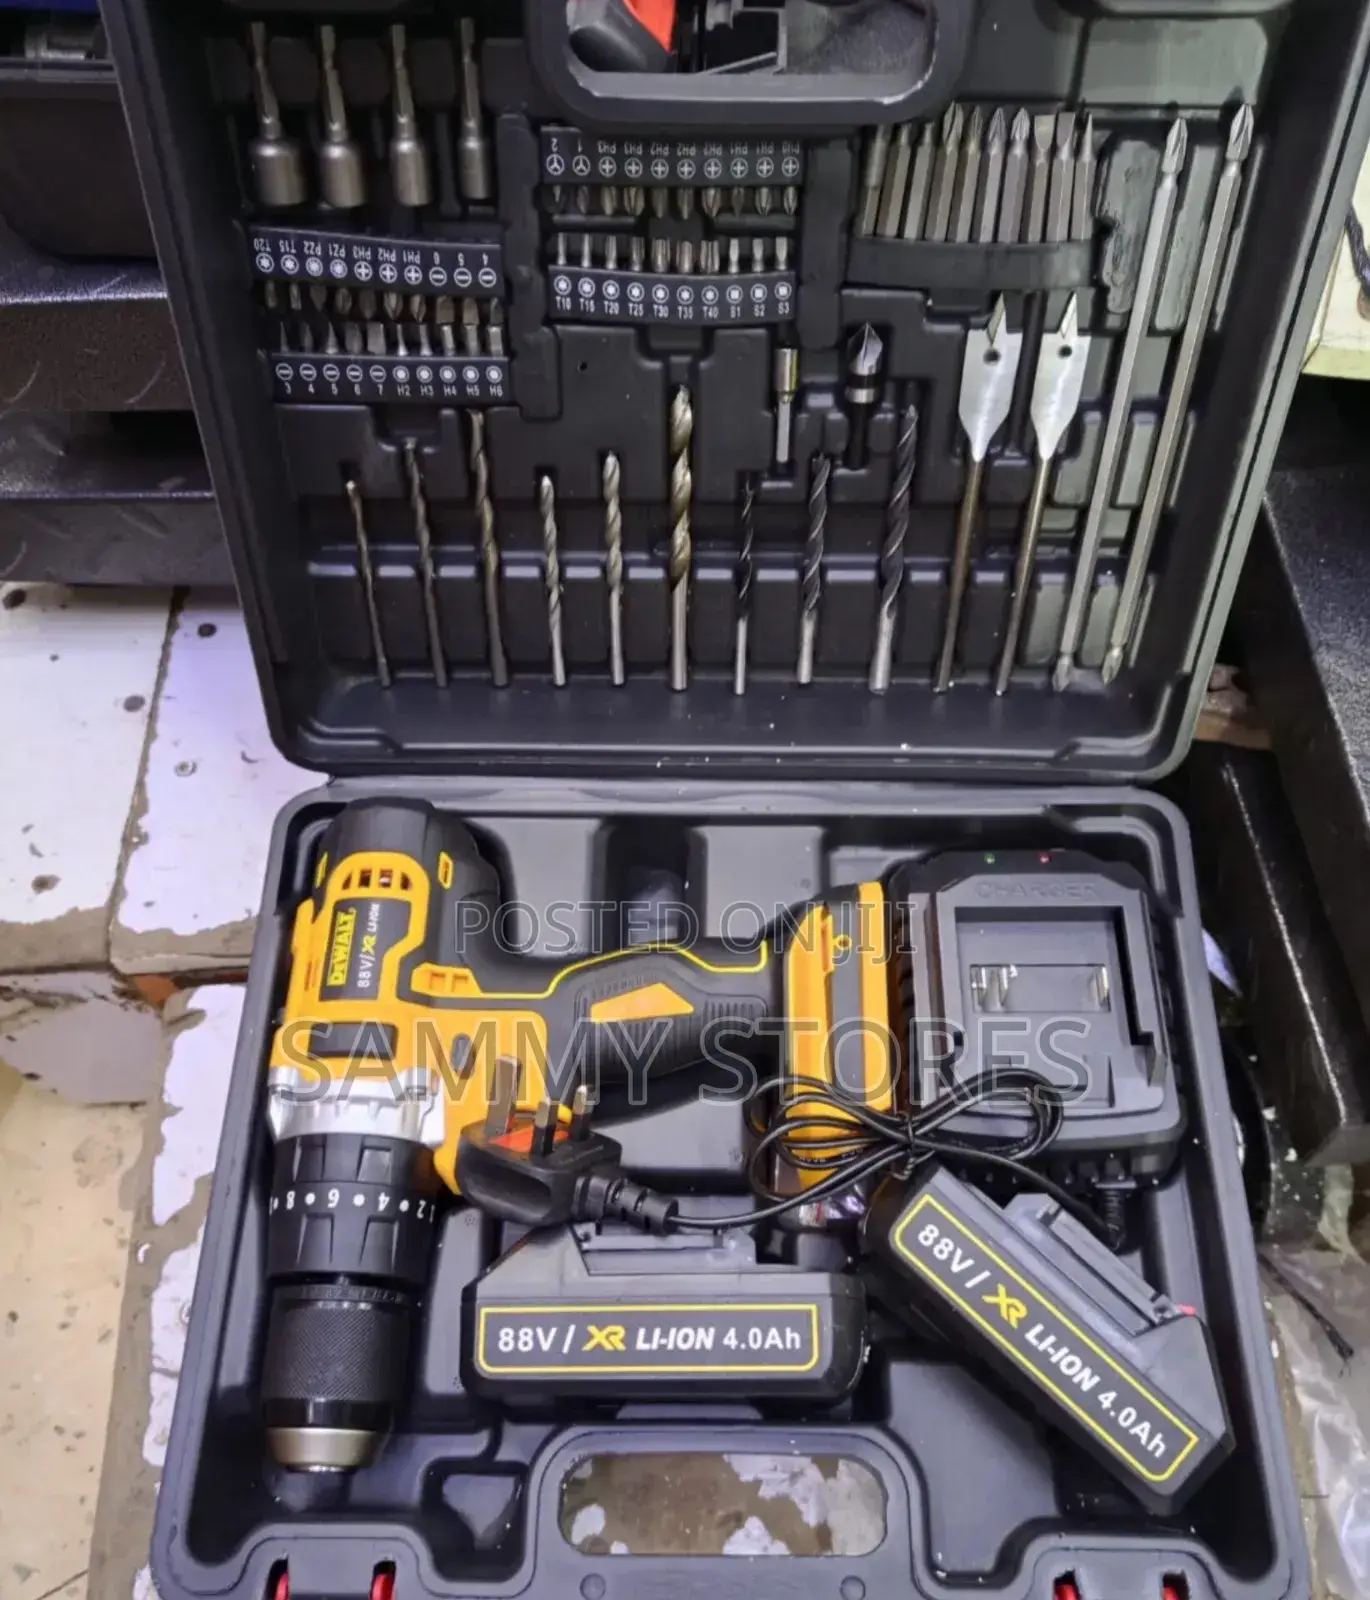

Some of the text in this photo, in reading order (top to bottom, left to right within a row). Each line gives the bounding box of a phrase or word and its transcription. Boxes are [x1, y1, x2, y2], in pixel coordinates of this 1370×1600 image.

[551, 137, 558, 152] 2
[253, 237, 271, 252] T20
[279, 238, 296, 254] T15
[303, 240, 322, 256] PZ2
[329, 242, 346, 257] PZ1
[353, 245, 372, 260] PH3
[378, 247, 397, 262] PH2
[403, 249, 421, 263] PH1
[458, 252, 465, 266] 5
[482, 252, 489, 266] 4
[556, 295, 571, 310] T10
[604, 300, 619, 315] T20
[628, 302, 644, 317] T25
[653, 304, 669, 318] T30
[677, 305, 693, 319] T35
[702, 305, 719, 319] T40
[753, 303, 765, 317] S2
[778, 301, 790, 315] S3
[284, 382, 503, 397] 3 4 5 6 7 H2 H3 H4 H5 H6
[977, 881, 1099, 900] CHARGER
[286, 1190, 296, 1210] 8
[327, 1188, 340, 1208] 6
[377, 1192, 390, 1212] 4
[497, 1326, 557, 1352] 88V
[581, 1324, 626, 1351] XR
[635, 1326, 715, 1351] LI-ION
[722, 1326, 801, 1350] 4.0Ah
[917, 1223, 975, 1274] 88V
[981, 1283, 1028, 1330] XR
[1024, 1323, 1101, 1393] LI-ION
[1097, 1390, 1168, 1458] 4.0Ah
